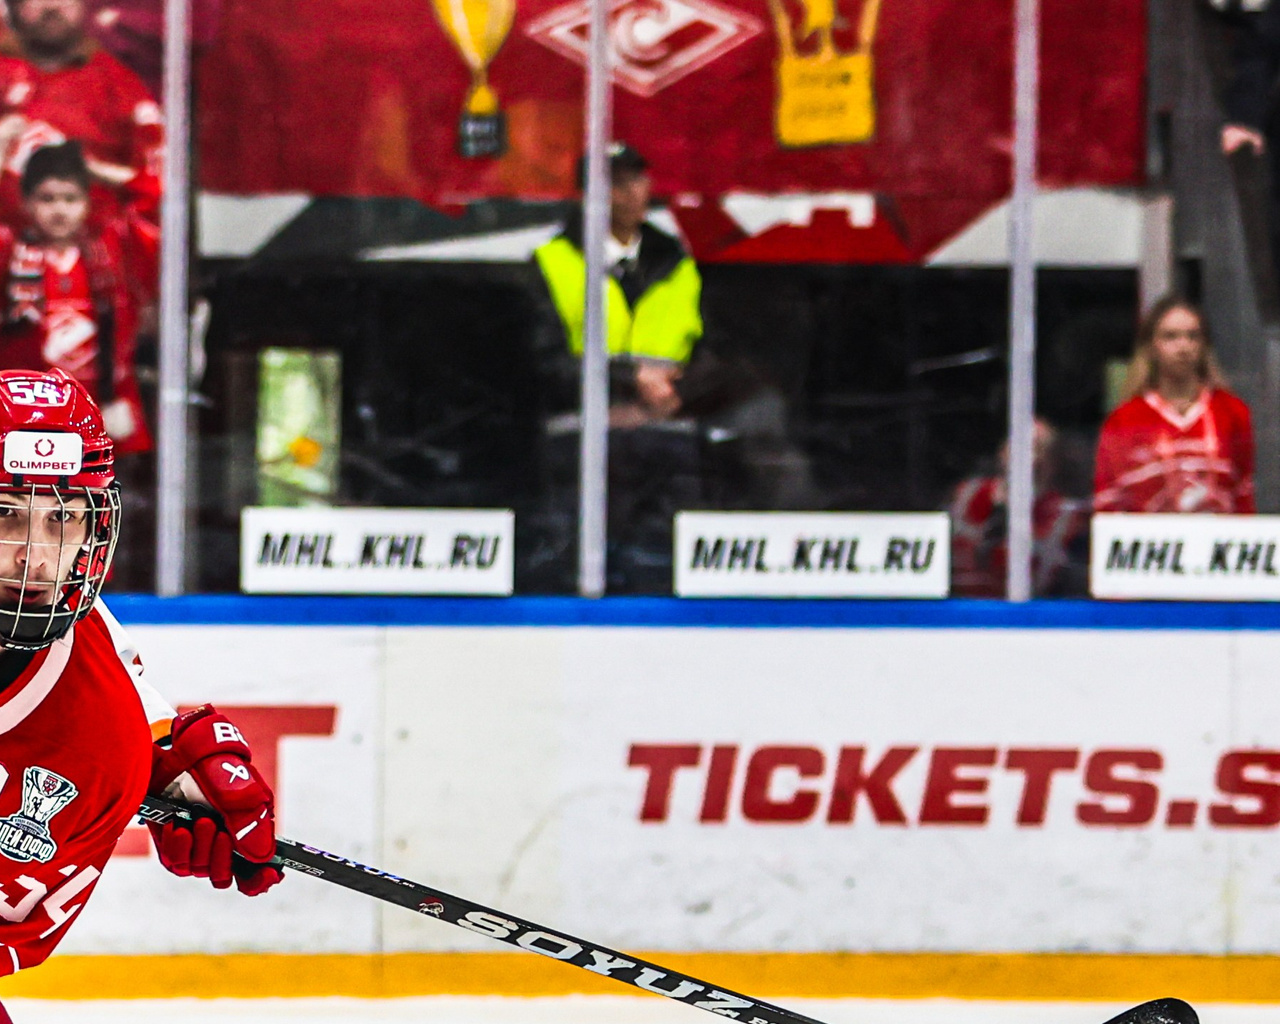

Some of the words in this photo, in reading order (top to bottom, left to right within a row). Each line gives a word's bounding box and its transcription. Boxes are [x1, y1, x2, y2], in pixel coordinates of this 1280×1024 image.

[7, 382, 61, 404] 54
[10, 460, 76, 471] OLIMPBET
[257, 532, 501, 570] MHL.KHL.RU
[690, 536, 936, 572] MHL.KHL.RU
[627, 743, 1280, 828] TICKETS.S
[457, 910, 754, 1019] SOYUZ
